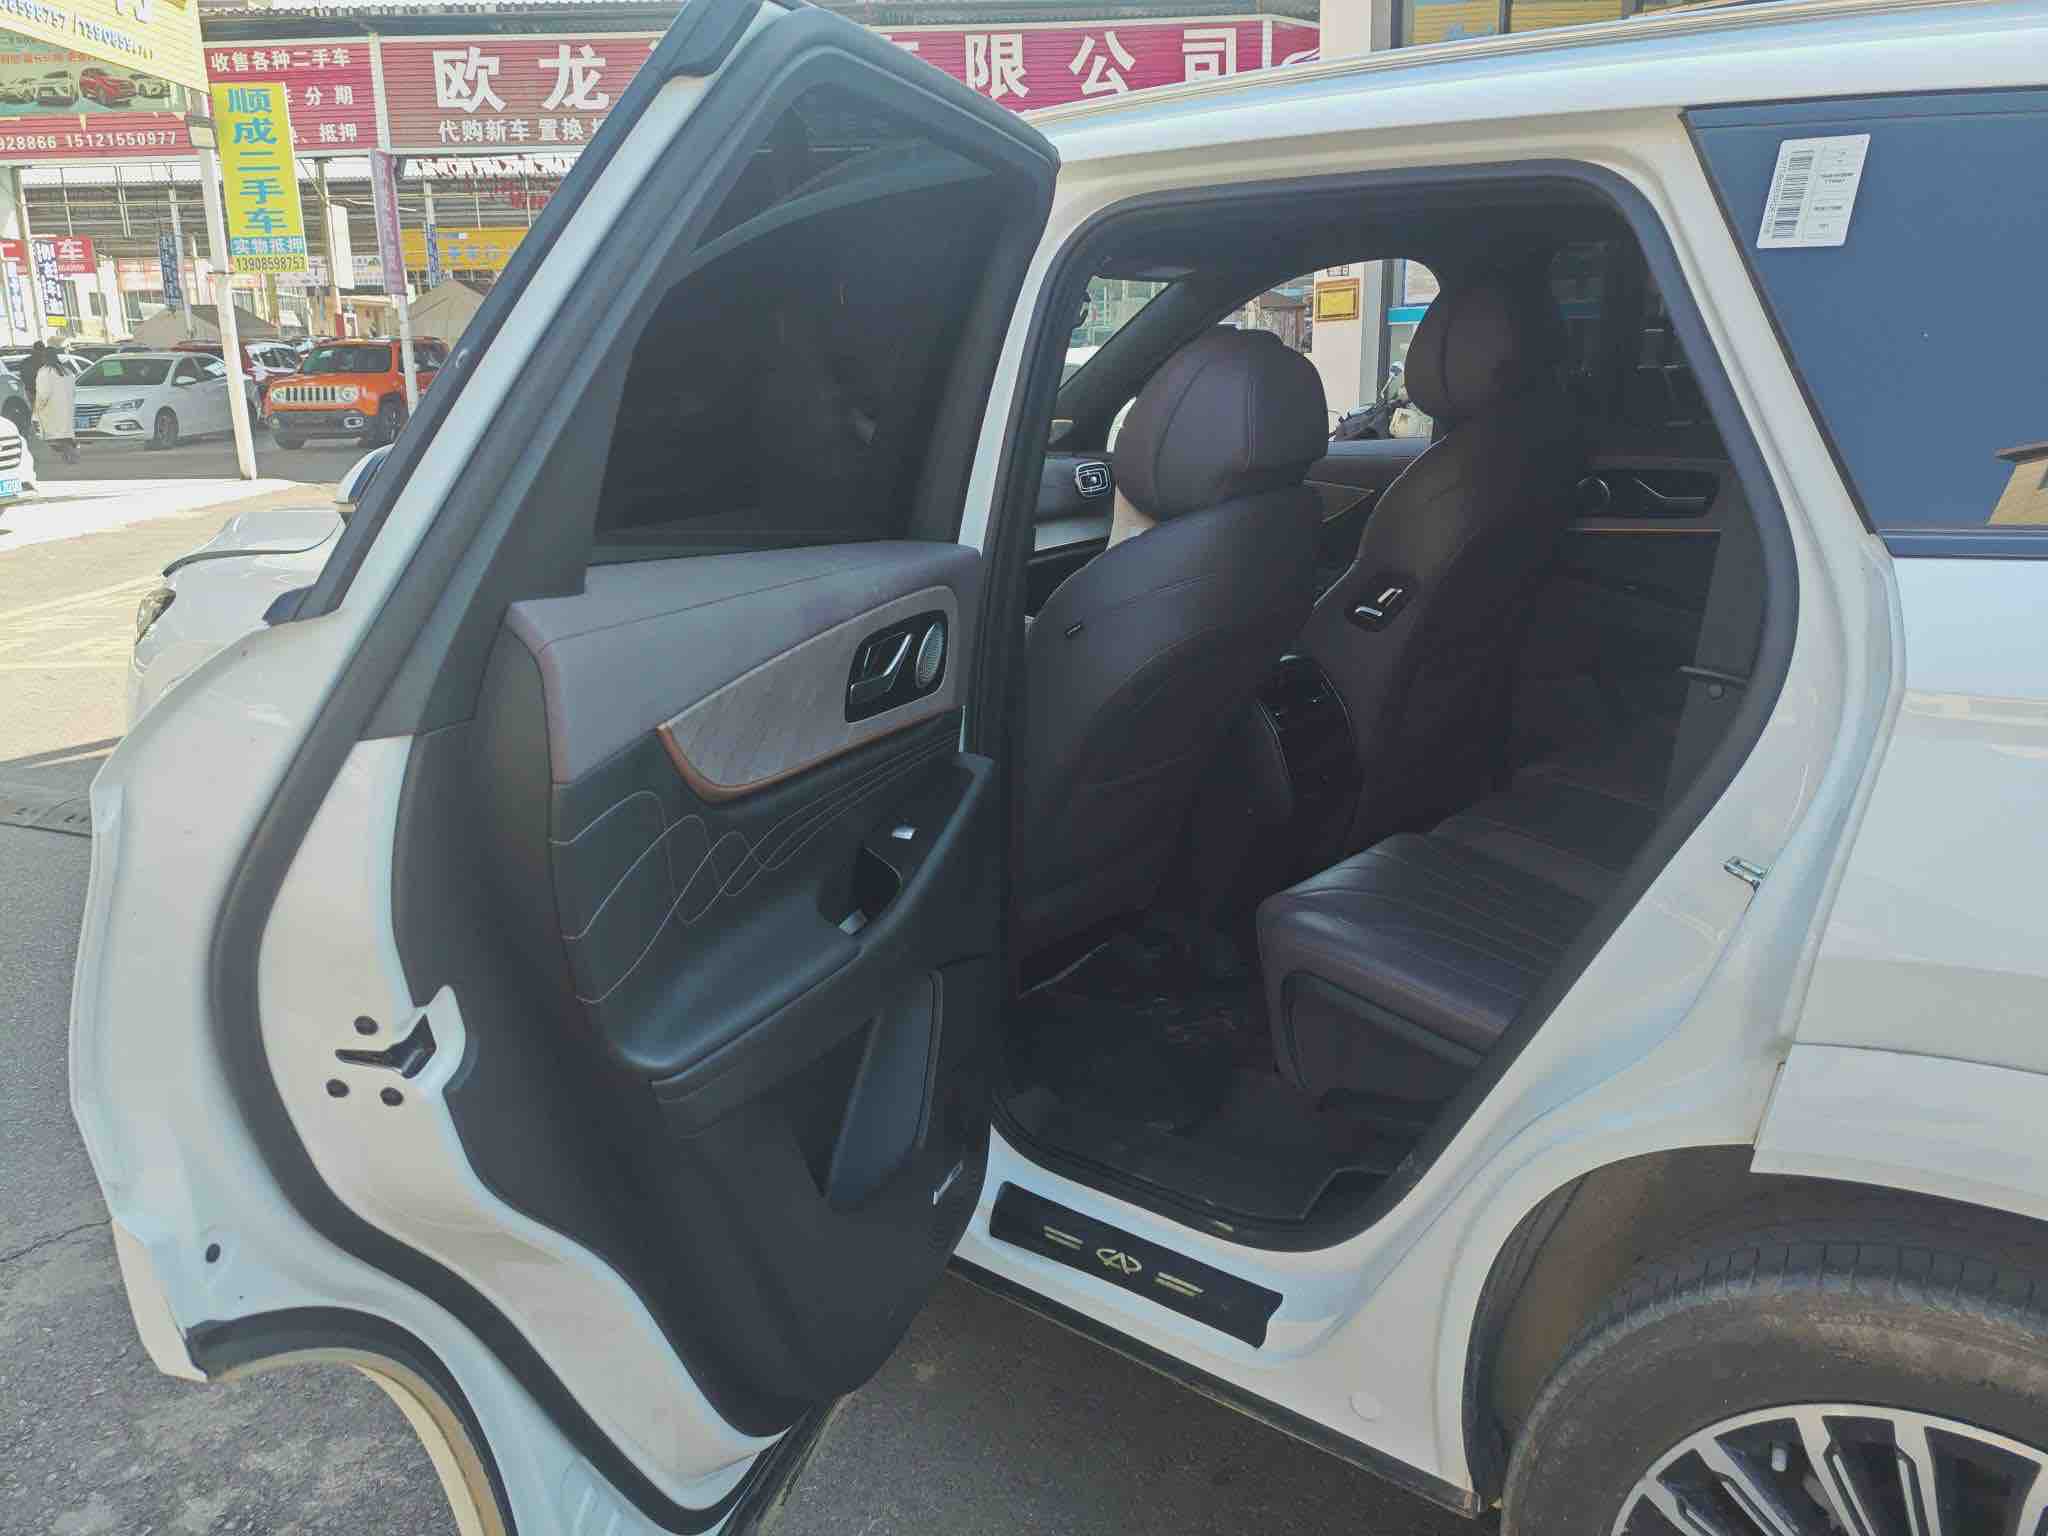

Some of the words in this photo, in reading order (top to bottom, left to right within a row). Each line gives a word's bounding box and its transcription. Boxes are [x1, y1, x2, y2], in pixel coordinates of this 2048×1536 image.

[211, 47, 352, 73] 收售各种二手车
[432, 44, 609, 112] 欧龙
[304, 85, 354, 106] 分期
[438, 119, 529, 144] 代购新车
[538, 118, 584, 142] 置换
[227, 87, 288, 233] 顺成二手车
